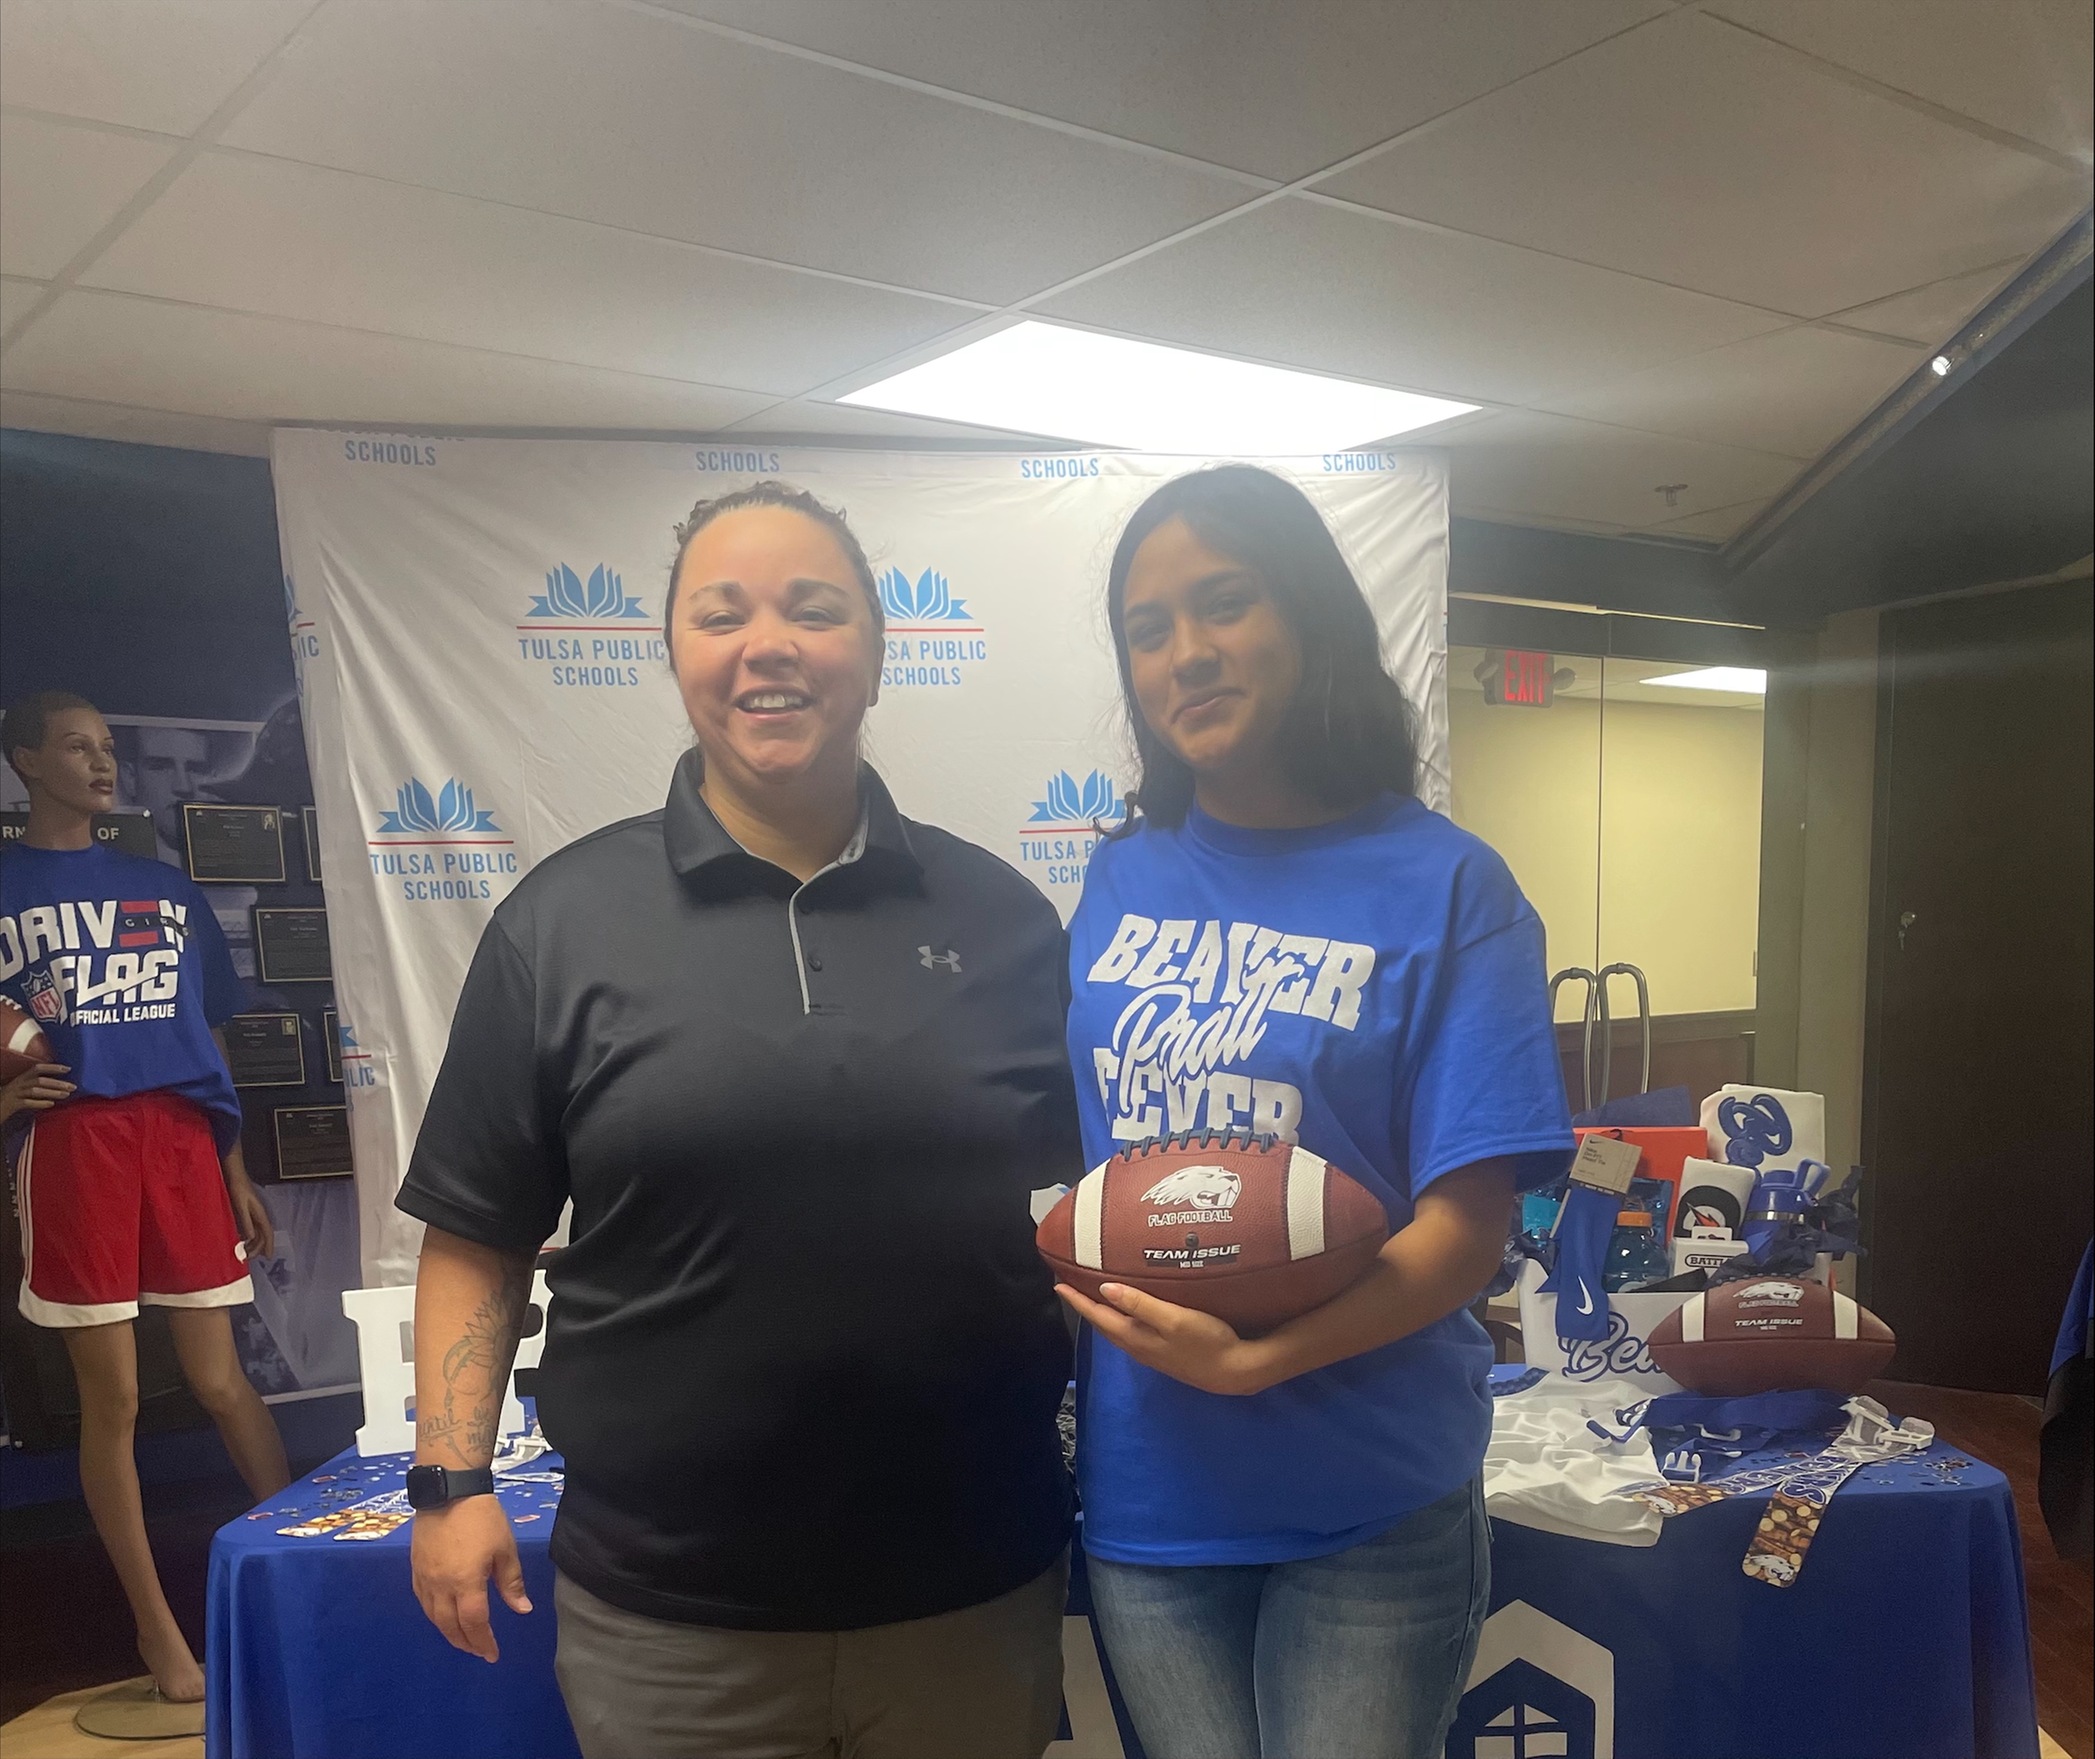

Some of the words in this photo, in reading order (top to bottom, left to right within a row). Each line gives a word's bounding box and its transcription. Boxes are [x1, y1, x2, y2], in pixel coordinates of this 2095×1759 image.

[345, 440, 437, 466] SCHOOLS
[696, 451, 780, 473] SCHOOLS
[1323, 452, 1397, 472] SCHOOLS
[1021, 457, 1099, 478] SCHOOLS
[518, 639, 584, 660] TULSA
[592, 639, 666, 661] PUBLIC
[887, 640, 912, 661] SA
[919, 640, 987, 661] PUBLIC
[552, 666, 639, 686] SCHOOLS
[882, 666, 961, 686] SCHOOLS
[1504, 649, 1551, 705] EXIT
[97, 827, 120, 840] OF
[1020, 840, 1076, 861] TULSA
[370, 853, 435, 875] TULSA
[444, 852, 517, 874] PUBLIC
[403, 880, 491, 901] SCHOOLS
[1086, 913, 1376, 1032] BEAVER
[50, 950, 179, 1025] FLAG
[123, 1003, 176, 1023] LEAGUE
[1148, 1213, 1177, 1227] FLAG
[1178, 1210, 1233, 1224] FOOTBALL
[1144, 1249, 1189, 1259] TEAM
[1192, 1244, 1241, 1259] ISSUE
[1735, 1319, 1768, 1327] TEAM
